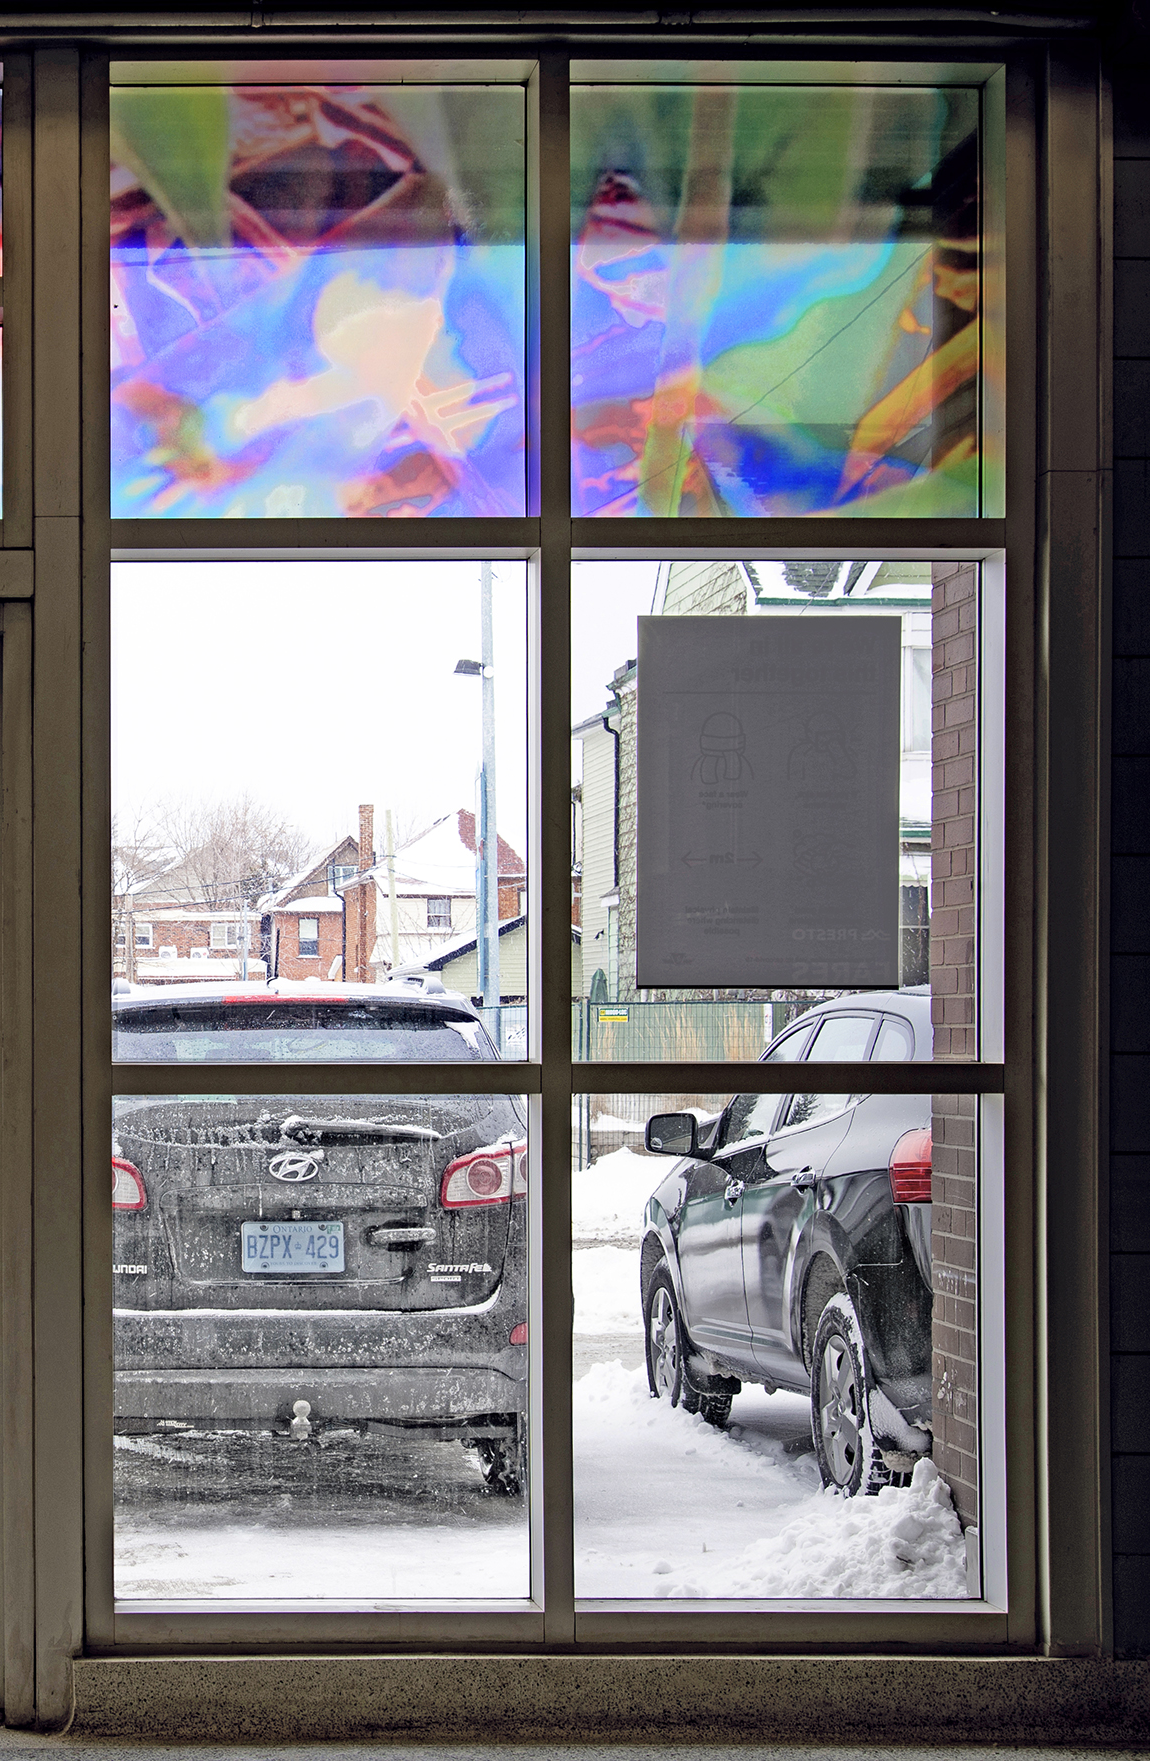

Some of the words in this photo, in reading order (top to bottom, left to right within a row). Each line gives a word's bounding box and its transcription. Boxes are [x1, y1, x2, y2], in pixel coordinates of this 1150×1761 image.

[272, 1225, 313, 1234] ONTARIO
[247, 1234, 292, 1259] BZPX
[305, 1234, 339, 1259] 429
